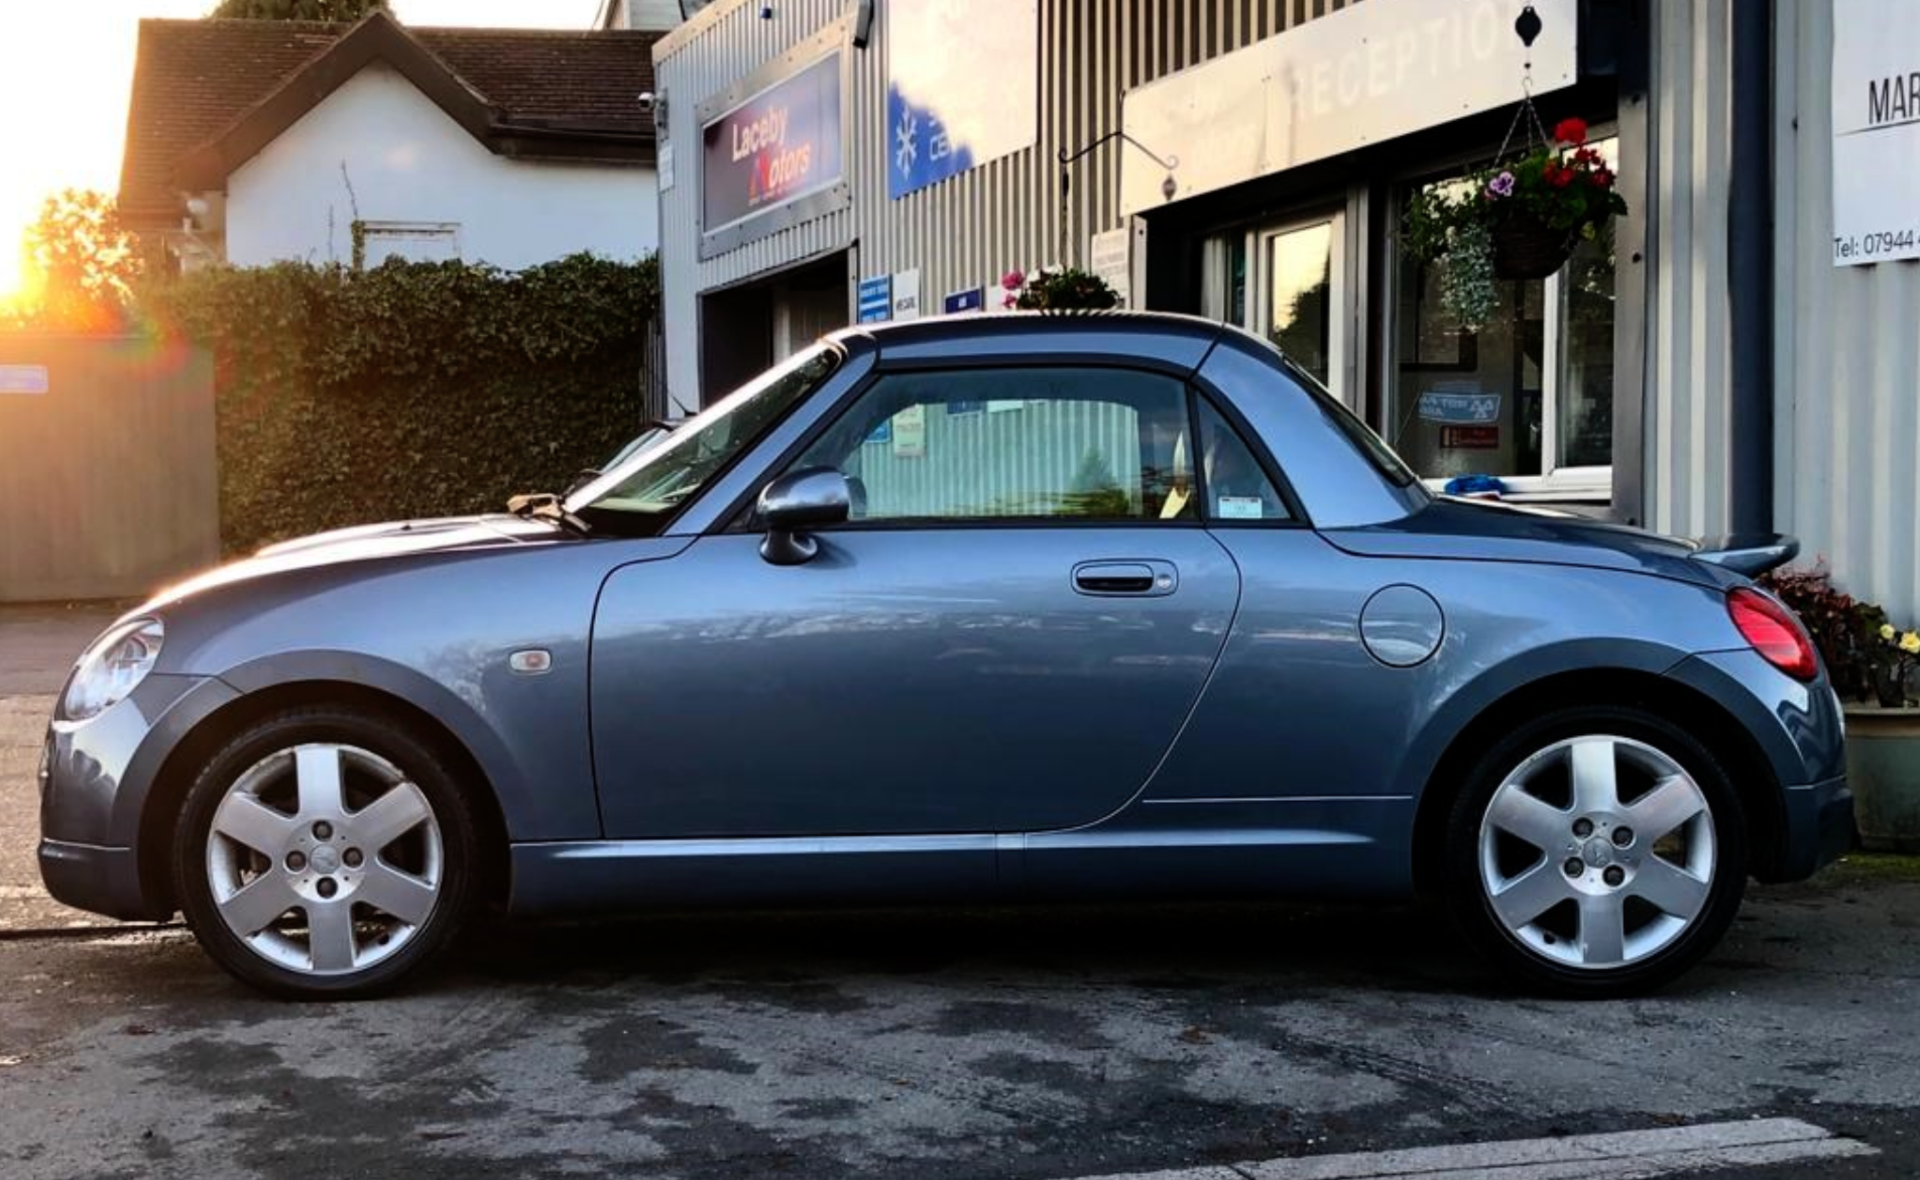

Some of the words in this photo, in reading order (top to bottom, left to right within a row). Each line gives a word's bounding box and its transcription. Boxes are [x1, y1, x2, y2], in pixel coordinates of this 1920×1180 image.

[1868, 72, 1920, 125] MAR
[732, 104, 788, 162] Laceby
[1834, 236, 1859, 258] Tel:
[1863, 230, 1914, 255] 07944
